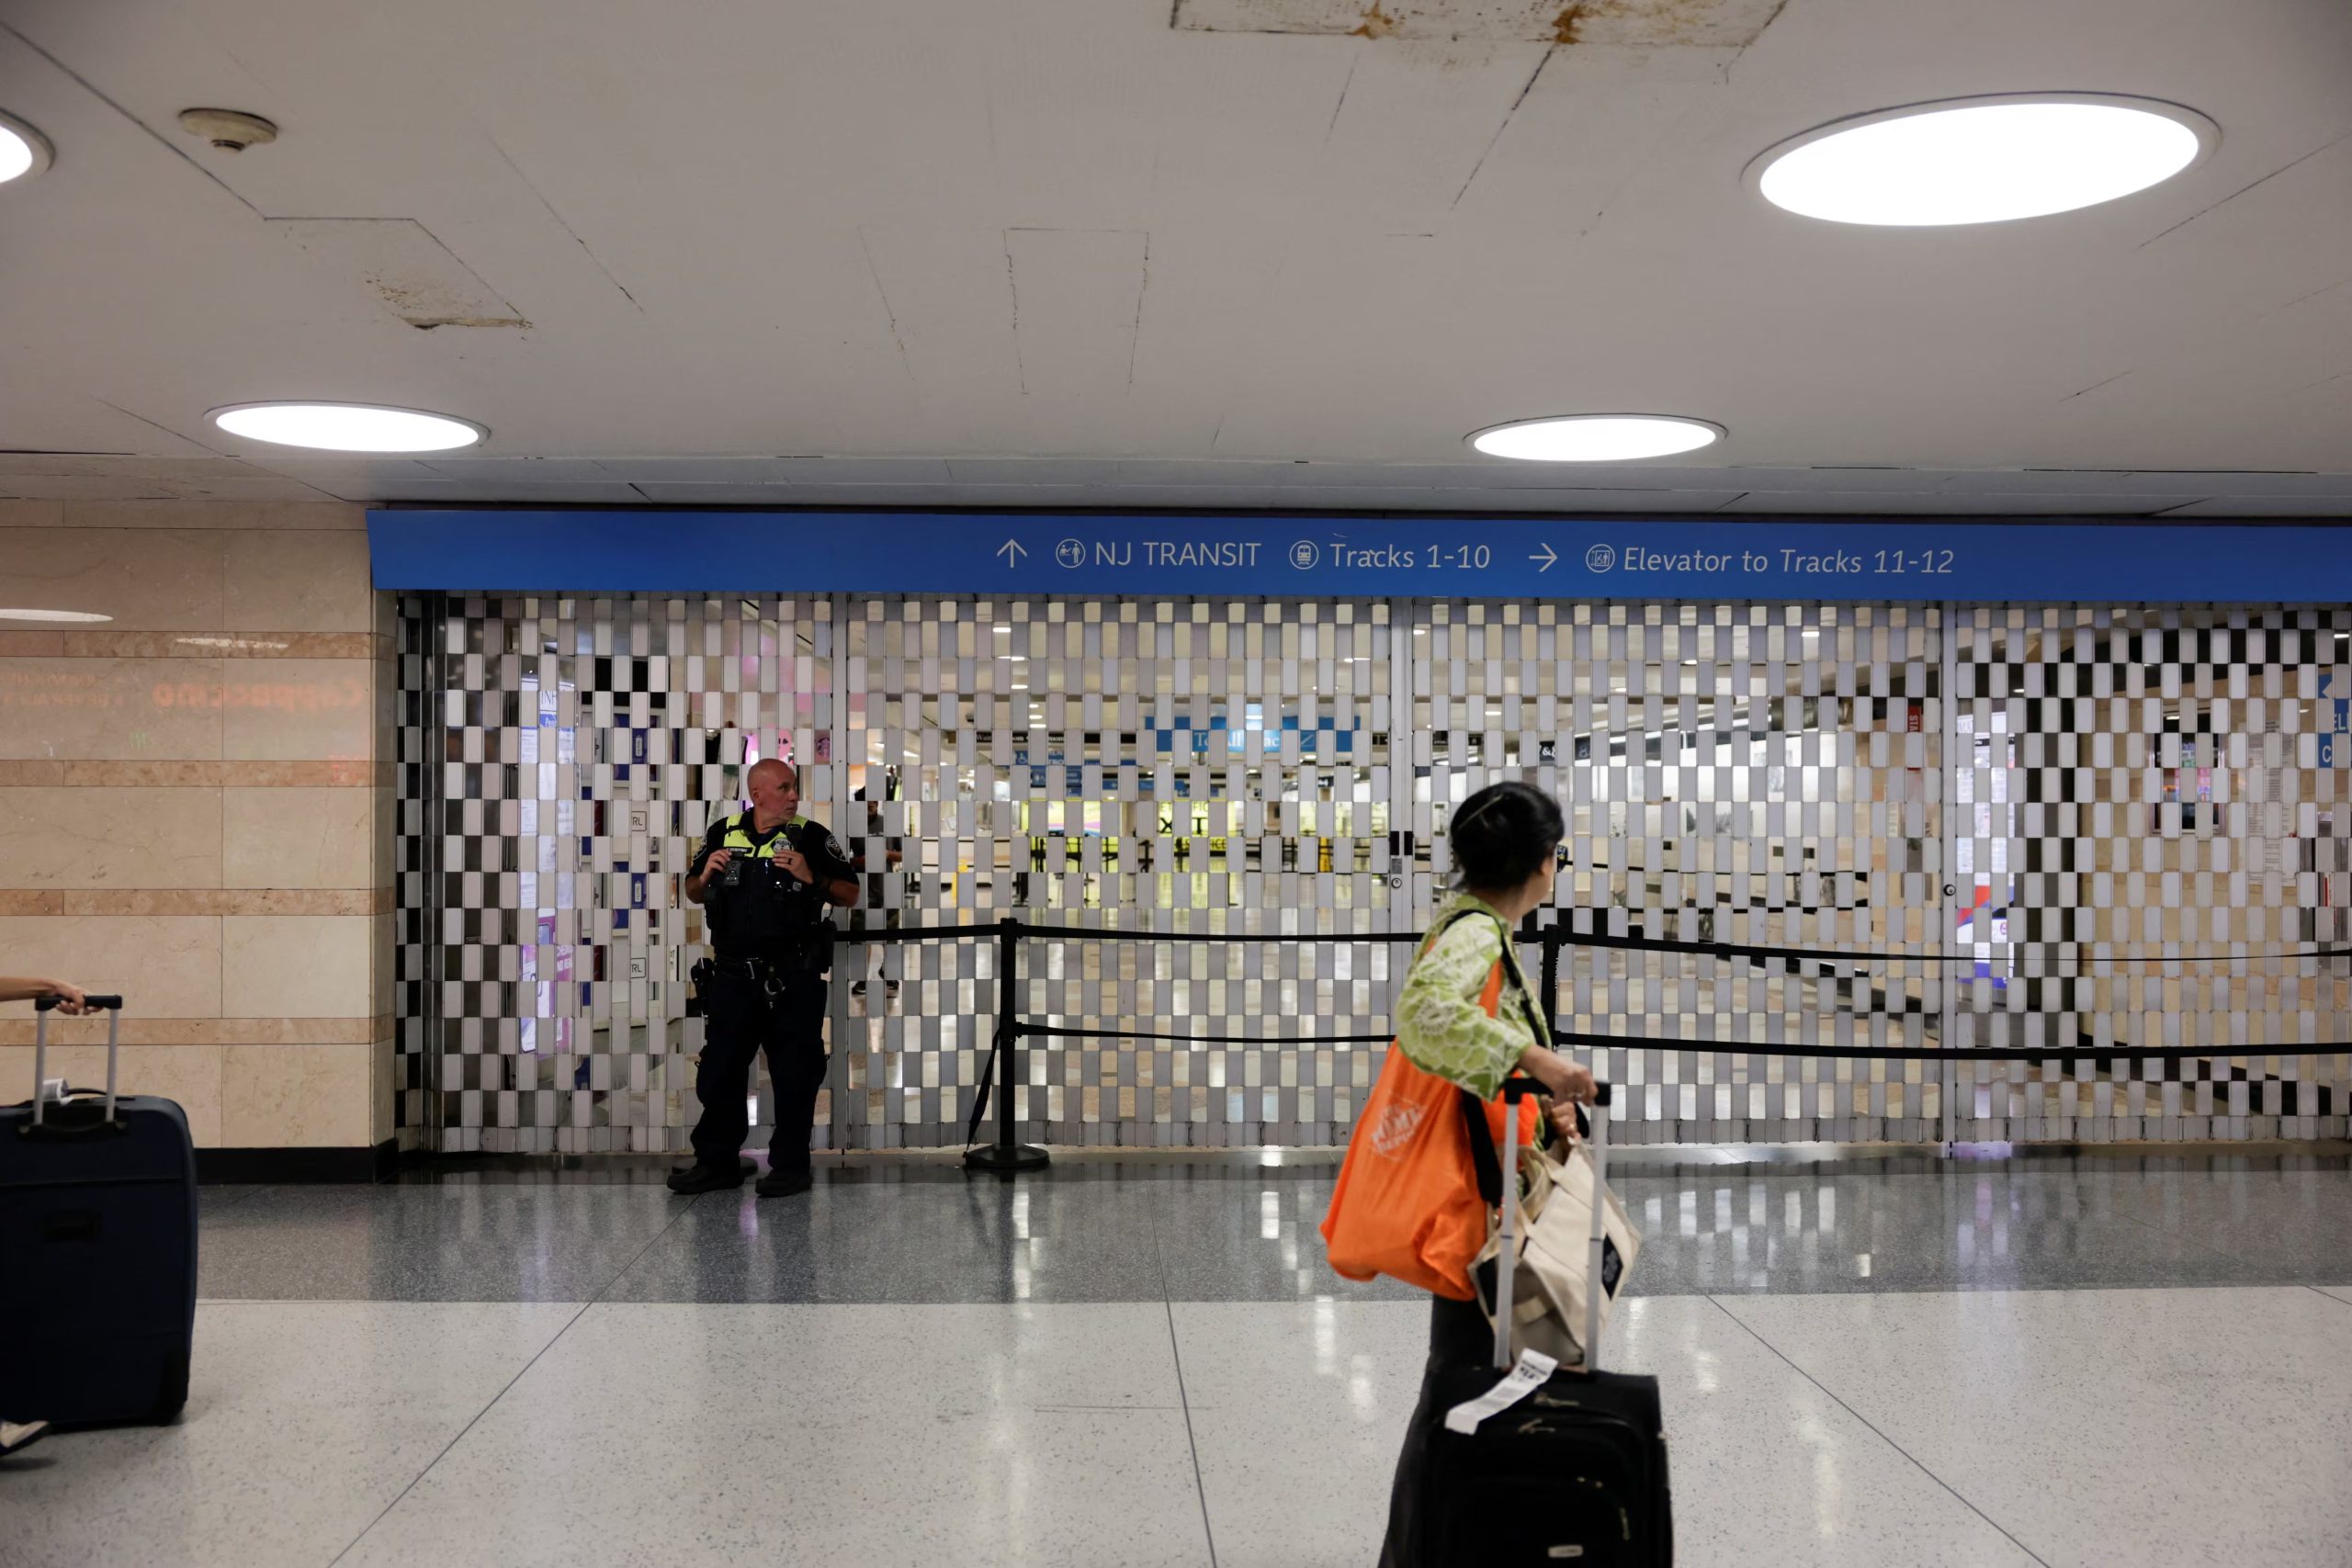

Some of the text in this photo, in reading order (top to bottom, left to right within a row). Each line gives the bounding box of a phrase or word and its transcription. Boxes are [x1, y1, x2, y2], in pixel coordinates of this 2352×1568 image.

[1095, 542, 1261, 567] NJ TRANSIT
[1330, 543, 1490, 569] Tracks 1-10
[1623, 547, 1954, 573] Elevator to Tracks 11-12
